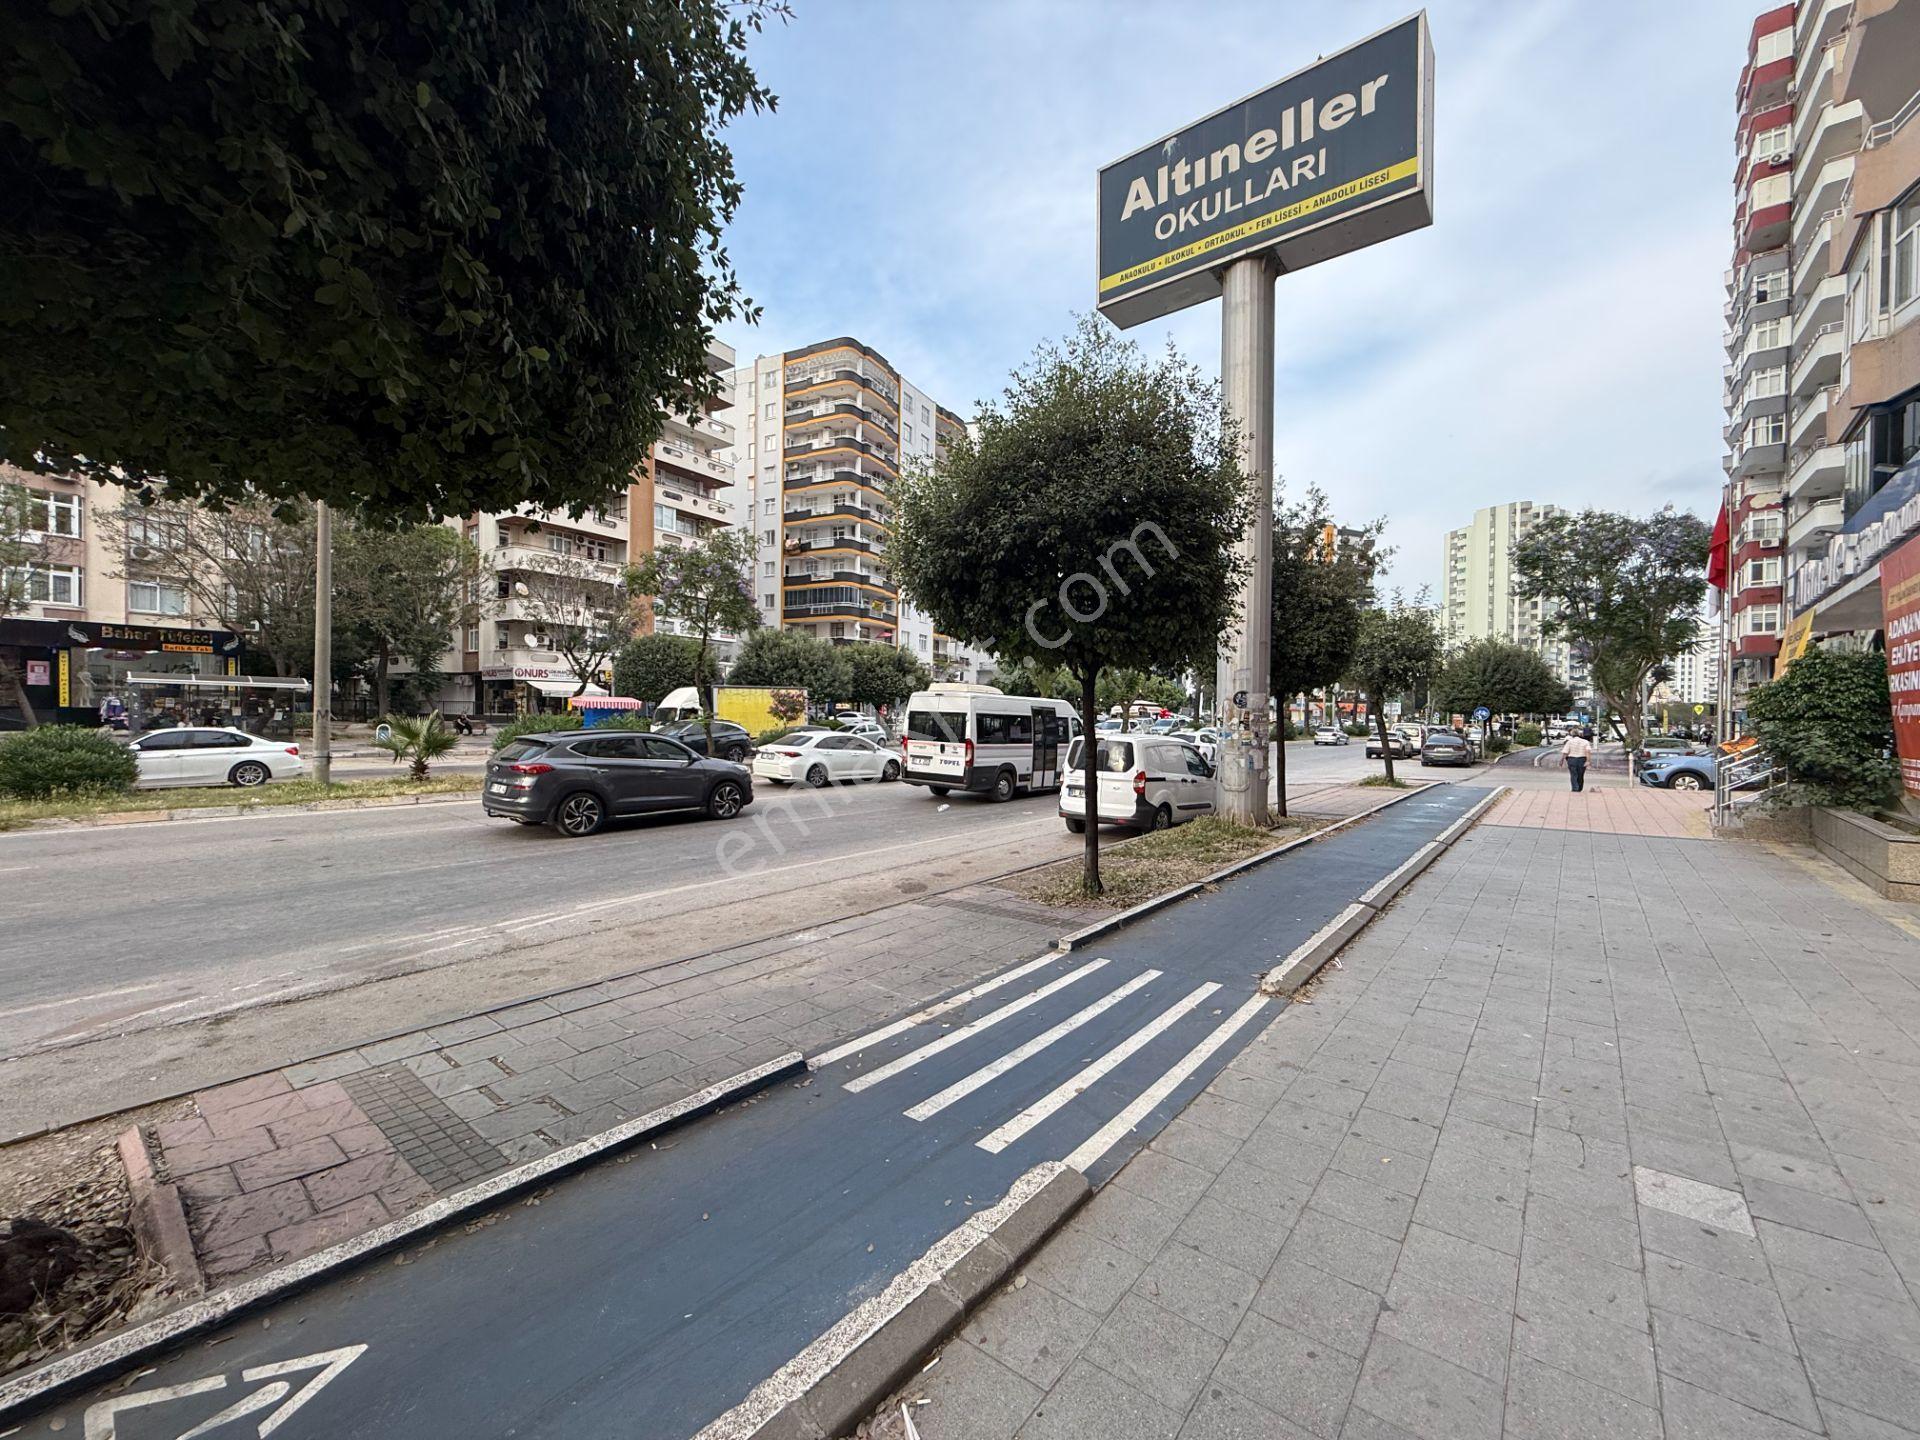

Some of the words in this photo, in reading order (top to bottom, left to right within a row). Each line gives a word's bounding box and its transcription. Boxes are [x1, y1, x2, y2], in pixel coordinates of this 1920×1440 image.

[1120, 74, 1389, 222] Altıneller
[1154, 148, 1327, 240] OKULLARI
[1119, 261, 1156, 283] ANAOKULU
[1204, 227, 1246, 250] ORTAOKUL
[1256, 216, 1272, 231] FEN
[1275, 204, 1302, 224] LİSESİ
[1313, 184, 1356, 209] ANADOLU
[1359, 169, 1390, 191] LİSESİ
